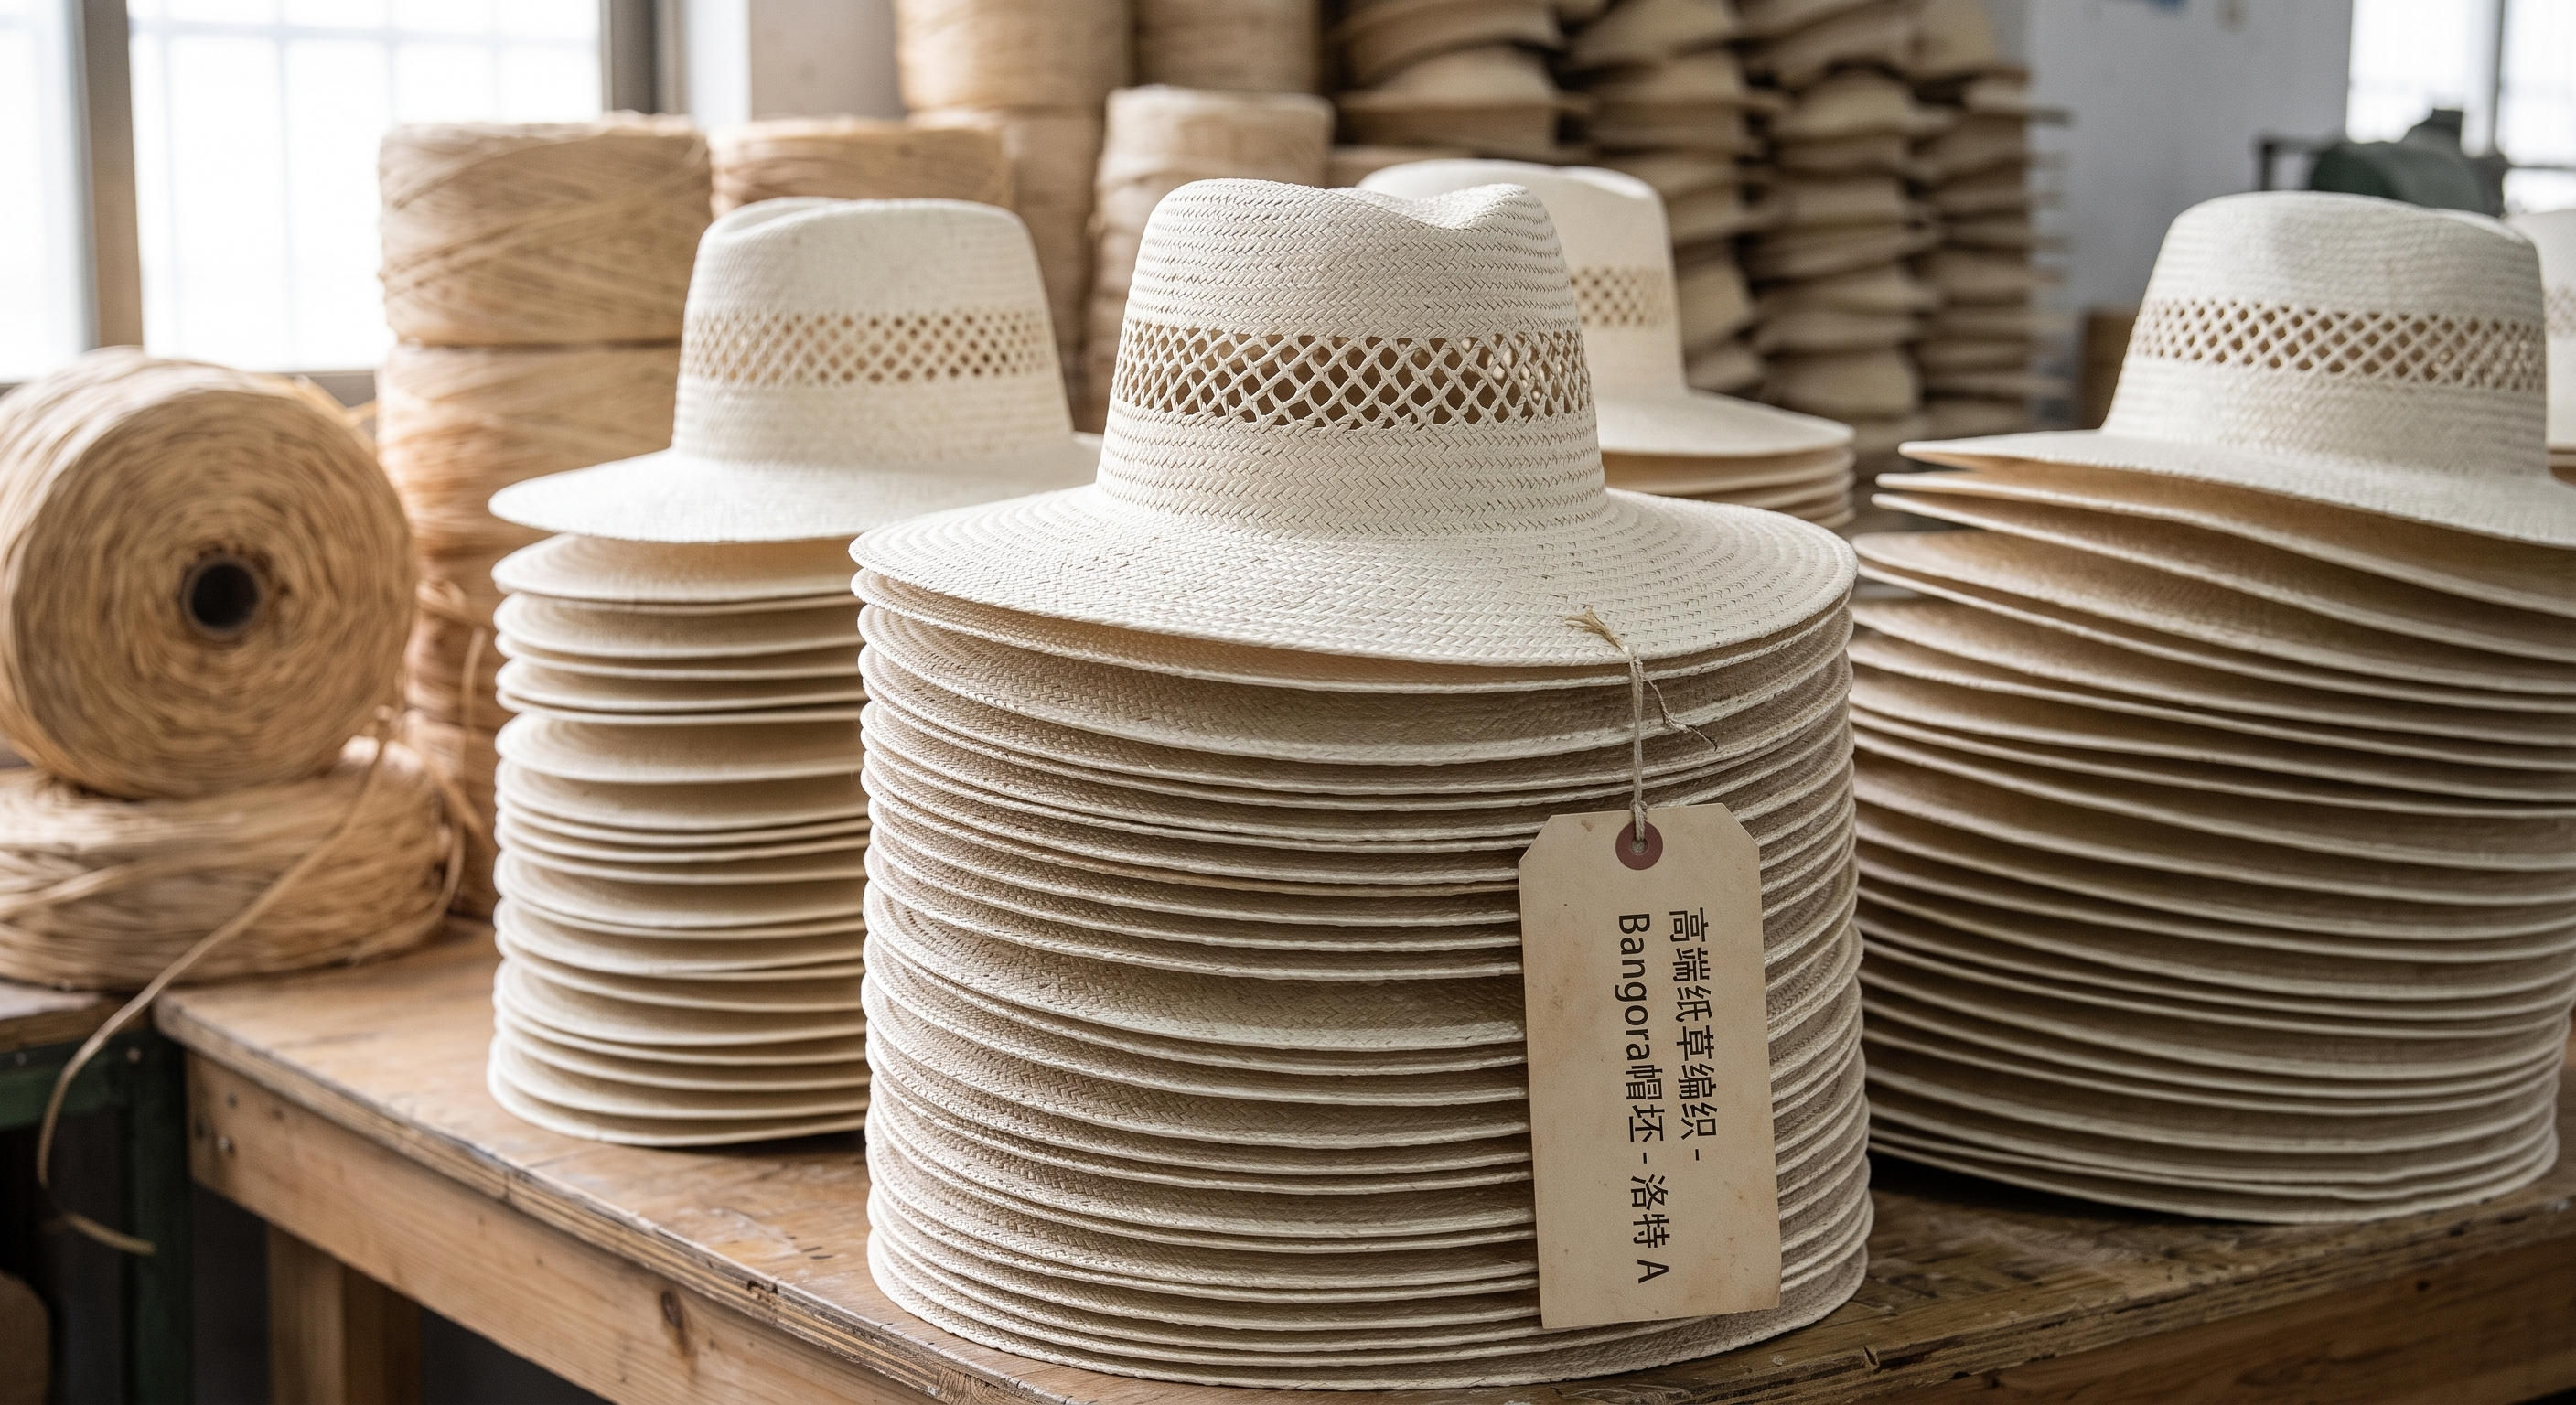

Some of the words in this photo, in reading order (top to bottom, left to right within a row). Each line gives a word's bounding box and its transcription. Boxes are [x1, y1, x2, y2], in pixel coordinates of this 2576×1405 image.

[1615, 913, 1666, 1143] Bangora帽坯
[1669, 906, 1718, 1141] 高端纸草编织
[1630, 1173, 1671, 1249] 洛特
[1637, 1258, 1669, 1284] A
